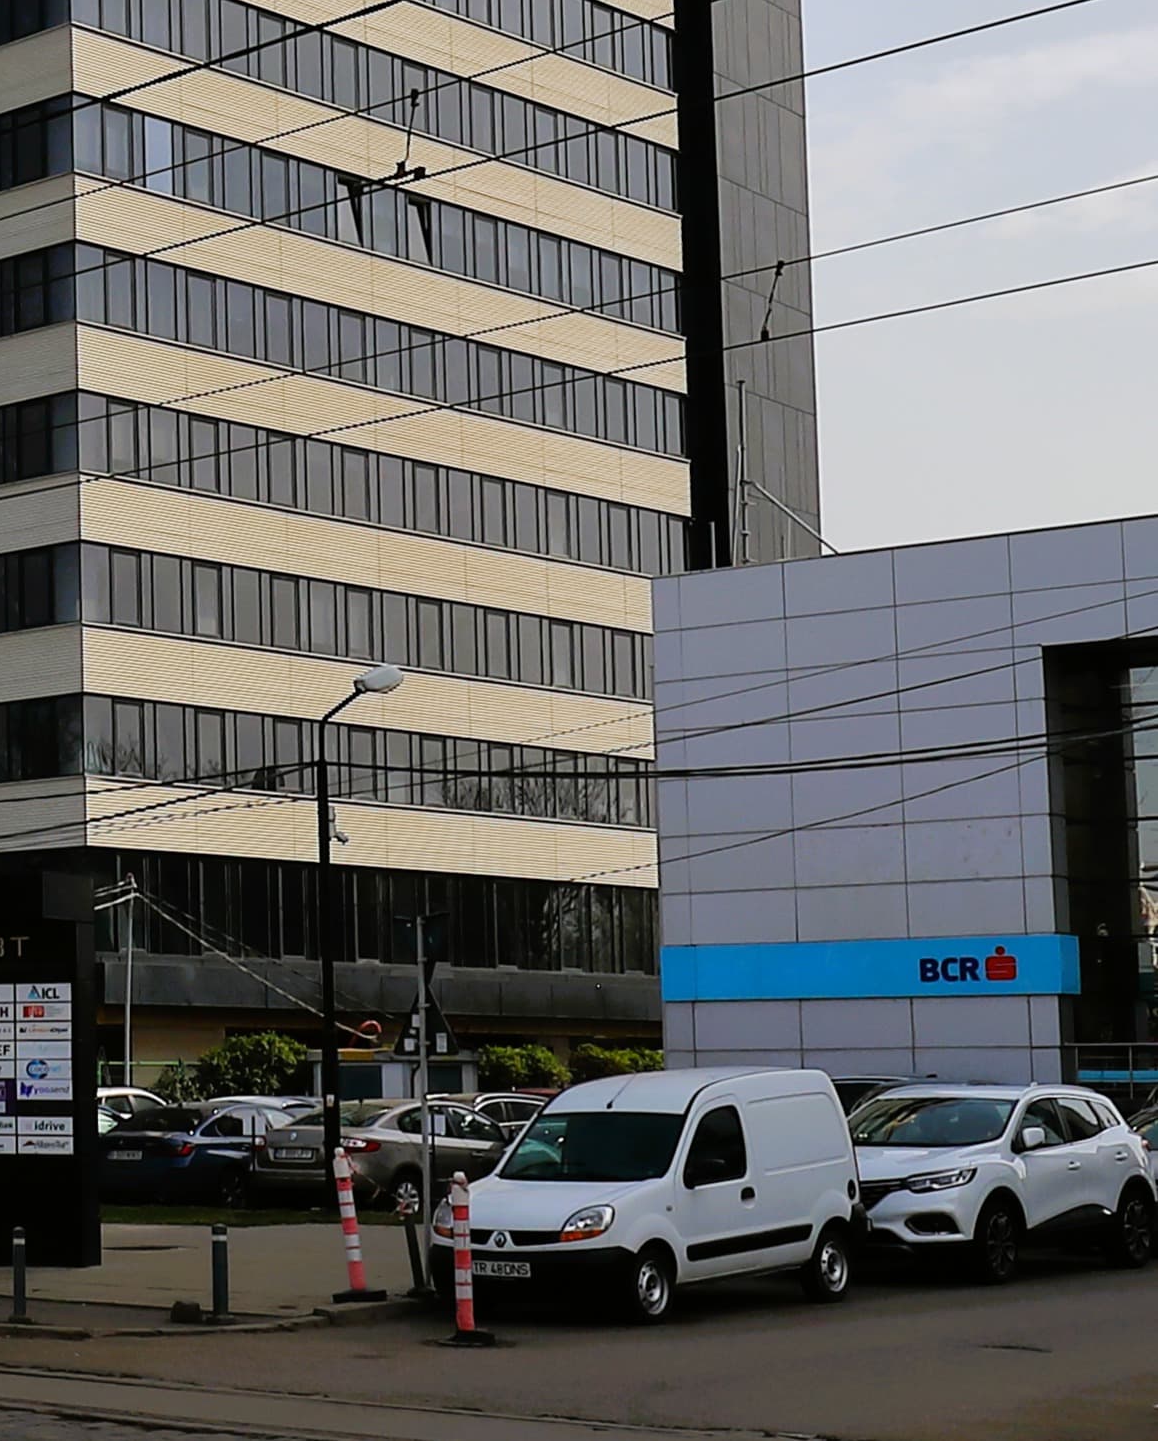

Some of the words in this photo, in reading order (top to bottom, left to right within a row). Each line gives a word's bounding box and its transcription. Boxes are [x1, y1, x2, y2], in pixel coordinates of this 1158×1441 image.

[919, 956, 981, 983] BCR
[42, 987, 60, 999] ICL
[474, 1262, 487, 1273] TR
